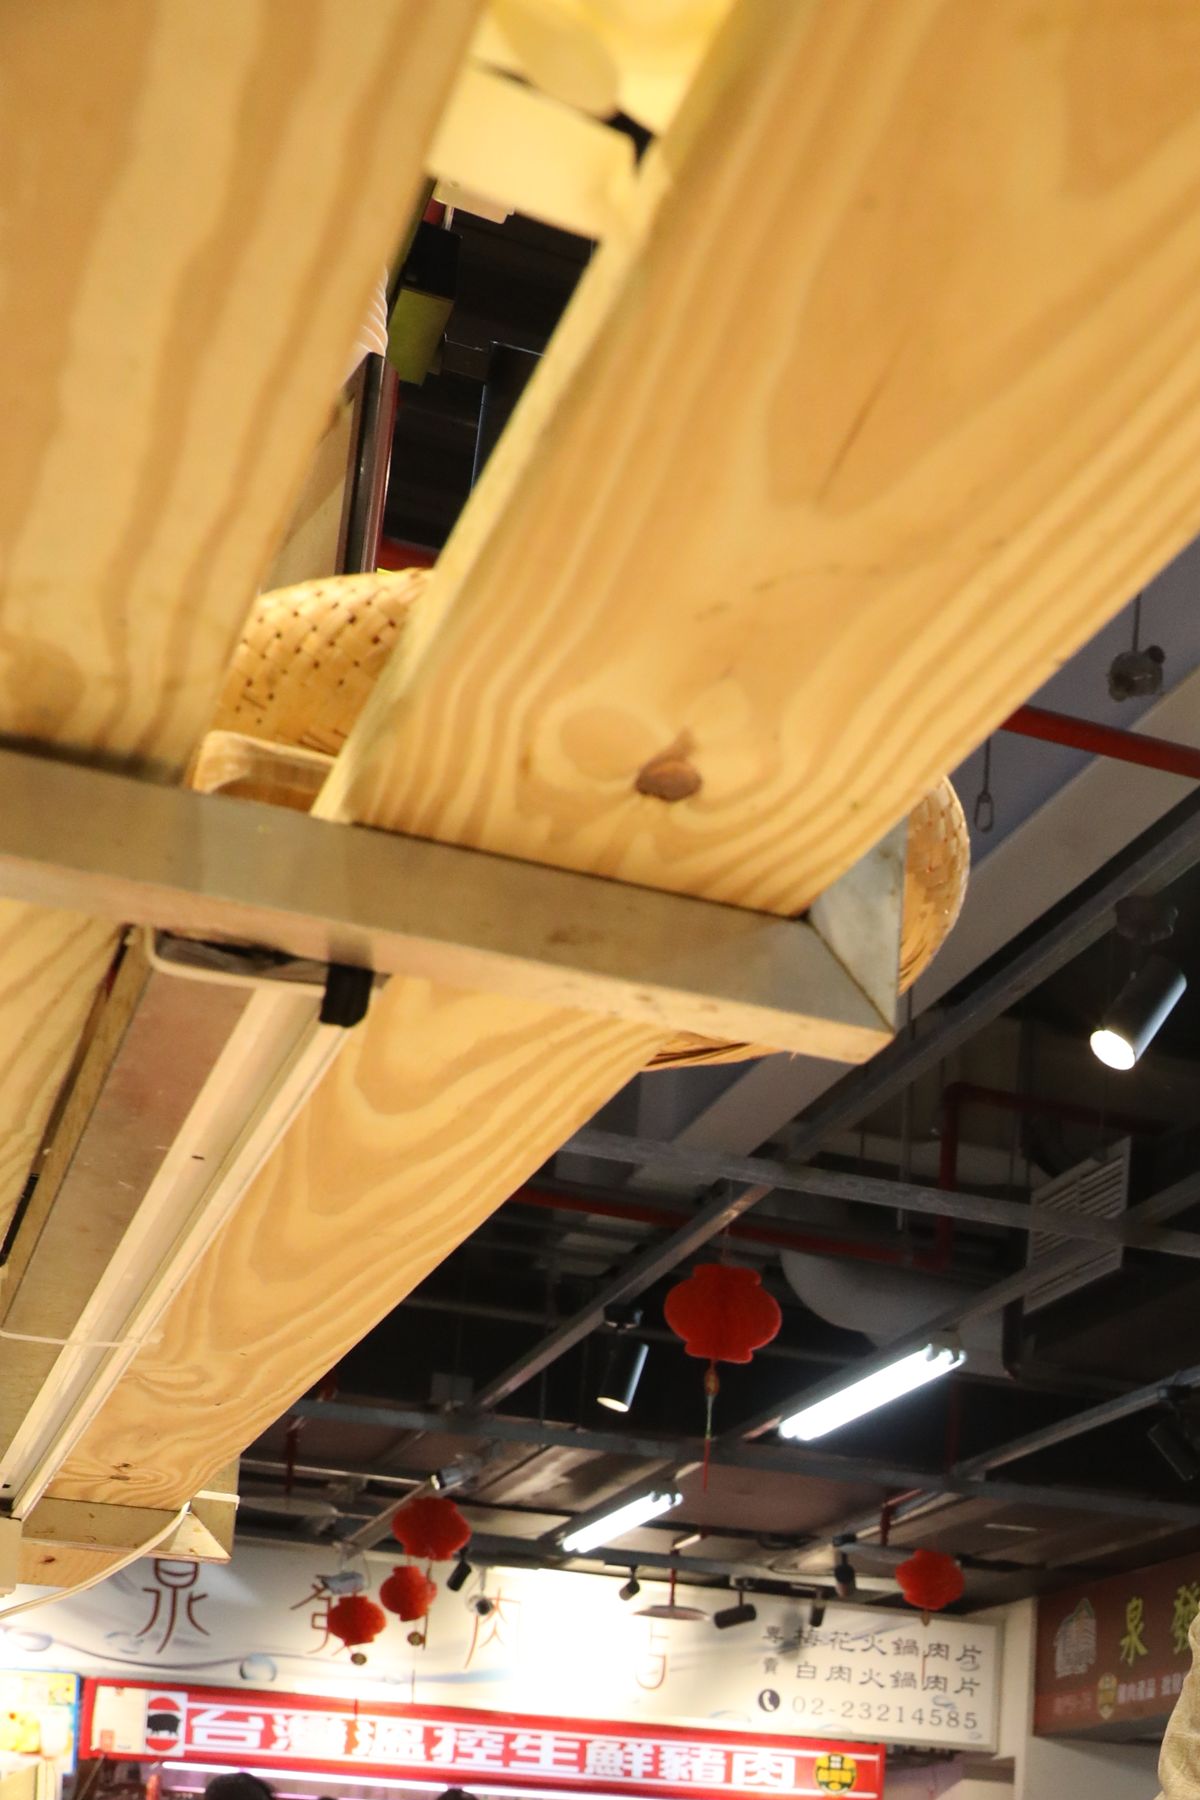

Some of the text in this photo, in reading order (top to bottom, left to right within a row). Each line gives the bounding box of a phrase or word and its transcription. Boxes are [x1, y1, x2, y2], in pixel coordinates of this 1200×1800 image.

[795, 1660, 982, 1697] 白肉火鍋肉片
[791, 1695, 979, 1730] 02-23214585
